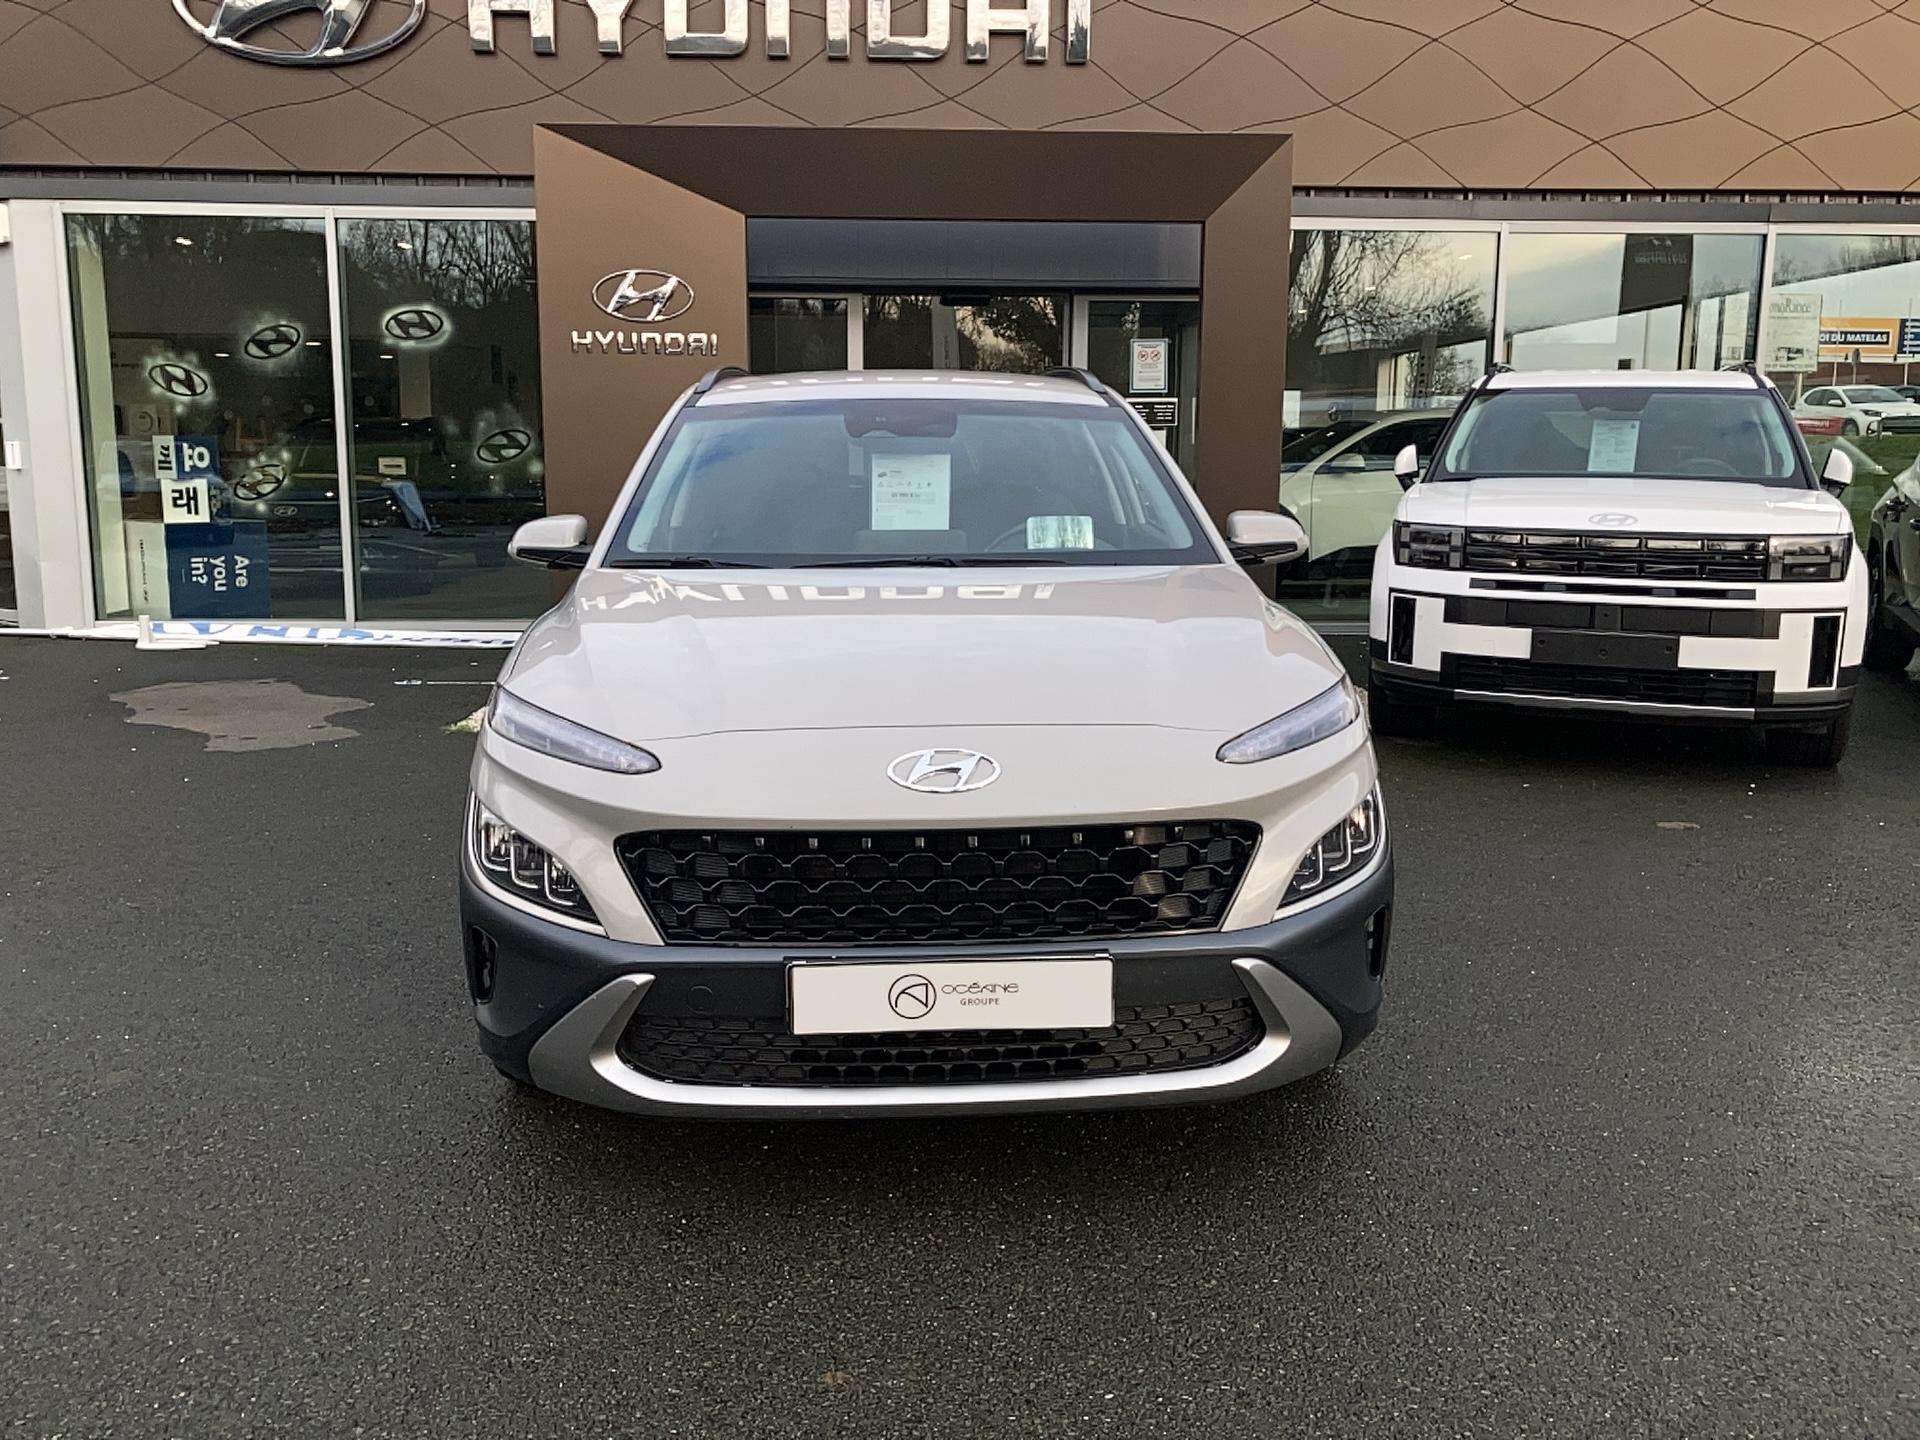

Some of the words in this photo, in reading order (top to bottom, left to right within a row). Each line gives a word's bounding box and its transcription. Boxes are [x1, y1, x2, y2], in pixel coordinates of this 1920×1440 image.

[571, 330, 718, 355] HYUNDAI
[1831, 332, 1845, 342] DU
[1846, 332, 1888, 343] MATELAS
[190, 556, 208, 584] in?
[210, 556, 227, 592] you
[233, 555, 250, 588] Are
[960, 997, 1000, 1006] GROUPE
